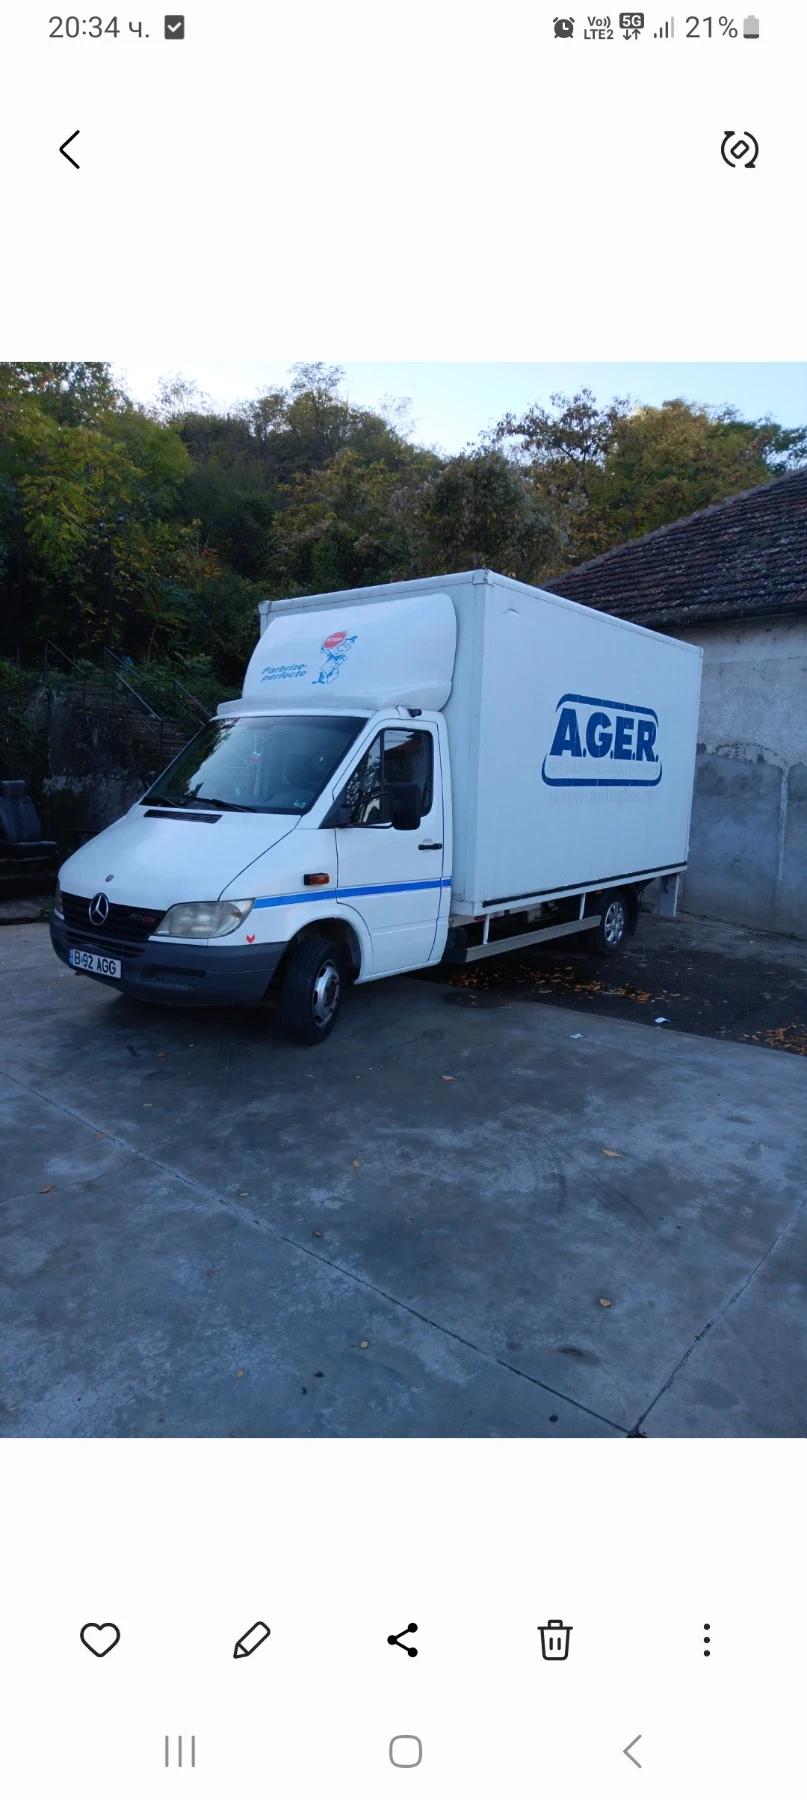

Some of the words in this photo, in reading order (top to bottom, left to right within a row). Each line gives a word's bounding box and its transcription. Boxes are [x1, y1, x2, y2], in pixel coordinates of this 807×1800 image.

[261, 670, 307, 682] perfecte
[549, 708, 659, 762] A.G.E.R.
[74, 950, 81, 965] B
[82, 953, 94, 970] 92
[96, 957, 117, 975] AGG
